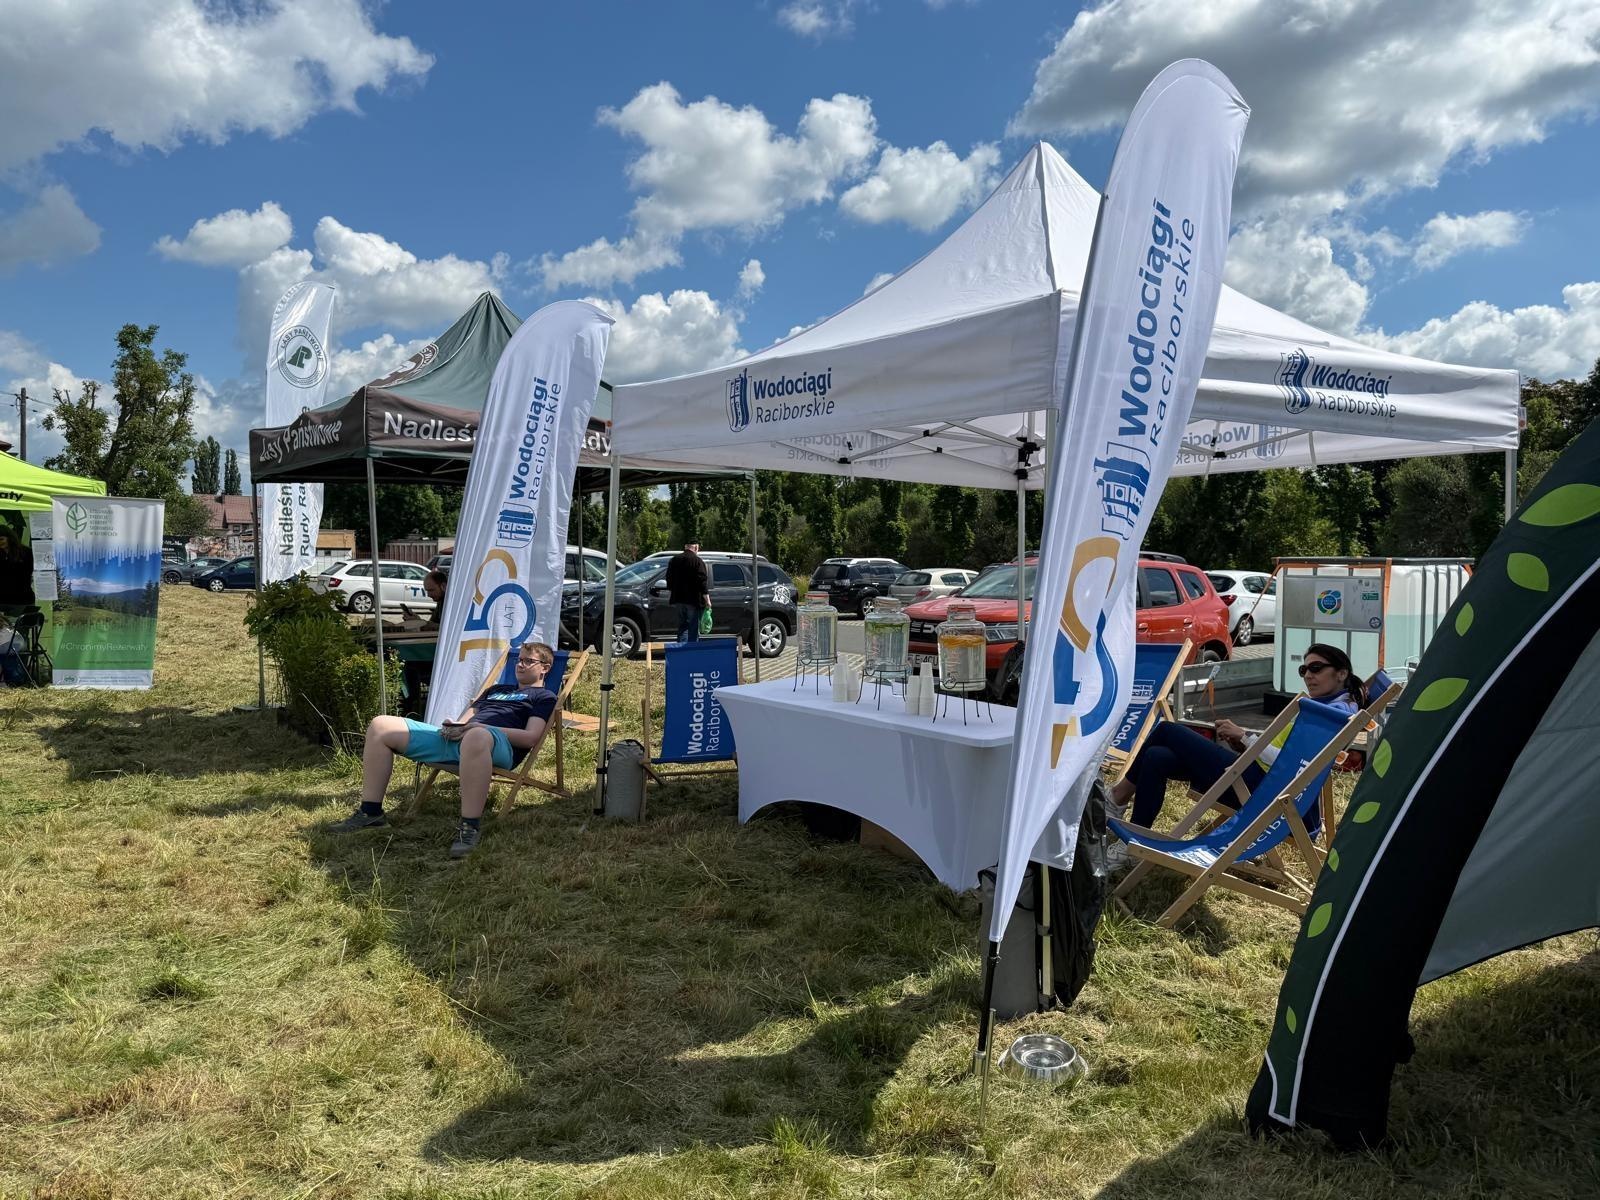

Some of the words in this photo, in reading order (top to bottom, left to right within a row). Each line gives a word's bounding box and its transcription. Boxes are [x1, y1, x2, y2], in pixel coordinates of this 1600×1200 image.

[1118, 198, 1173, 436] Wodociągi
[1149, 218, 1195, 447] Raciborskie
[753, 367, 832, 400] Wodociągi
[1312, 365, 1392, 399] Wodociągi
[756, 397, 835, 424] Raciborskie
[1315, 391, 1397, 418] Raciborskie
[260, 437, 283, 464] Lasy
[283, 420, 342, 453] Państwowe
[383, 411, 477, 442] Nadleś
[509, 377, 548, 499] Wodociągi
[528, 383, 561, 500] Raciborskie
[279, 483, 294, 556] Nadleśn
[300, 513, 310, 556] Rudy
[504, 605, 515, 628] LAT
[687, 672, 707, 754] Wodociągi
[1111, 710, 1142, 746] Wodo
